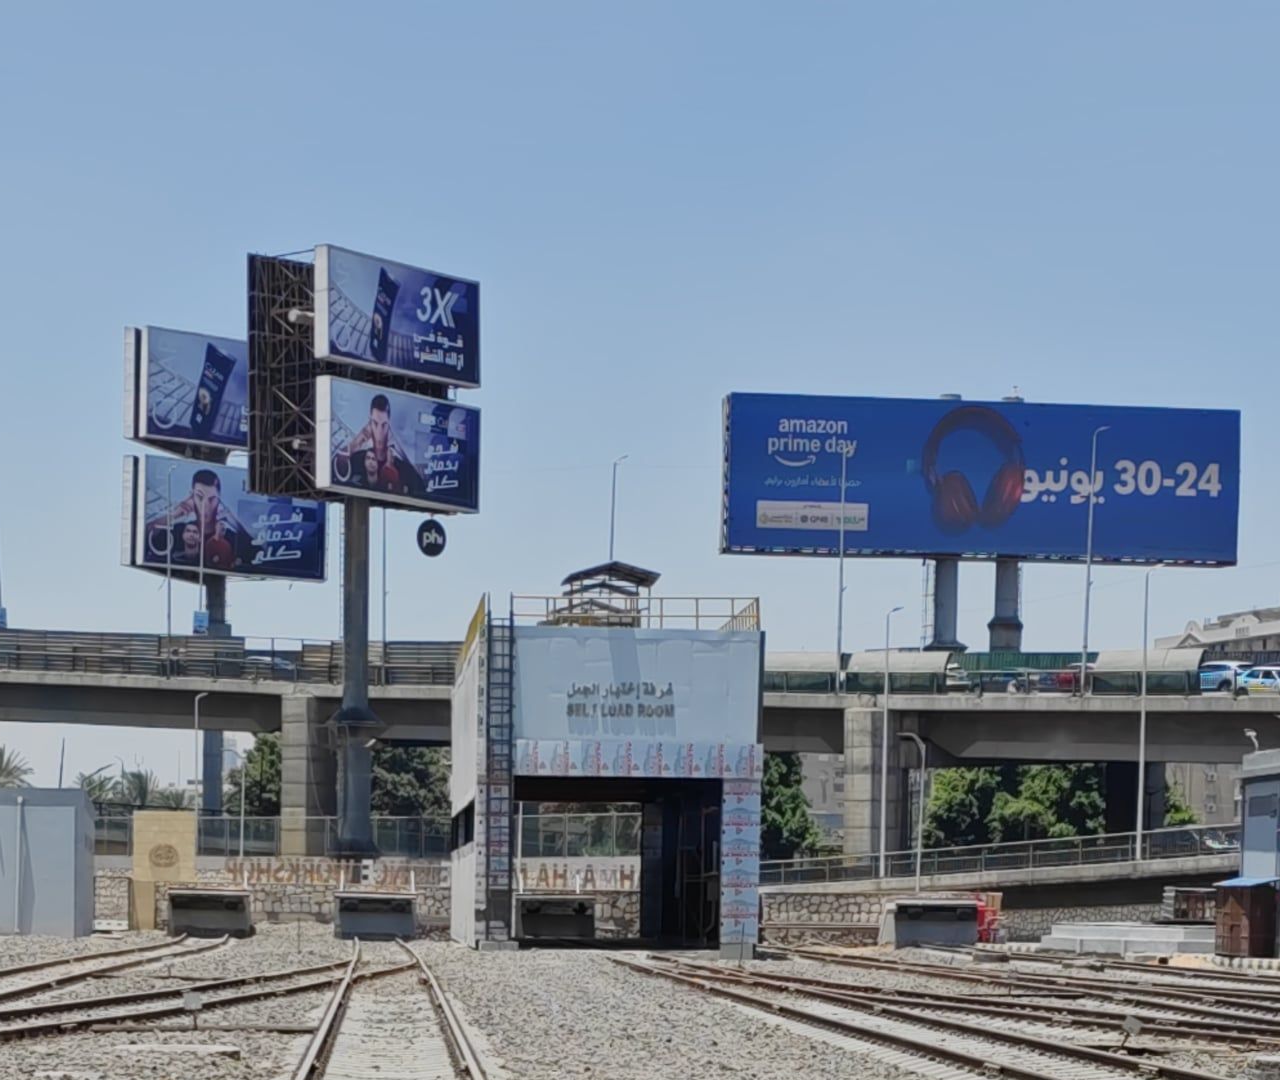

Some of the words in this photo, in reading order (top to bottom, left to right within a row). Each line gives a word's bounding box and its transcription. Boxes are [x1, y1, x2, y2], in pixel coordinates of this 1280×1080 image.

[778, 418, 848, 434] amazon
[767, 434, 821, 455] prime
[825, 436, 857, 458] day
[1020, 457, 1105, 504] يونيو
[637, 703, 675, 718] ROOM
